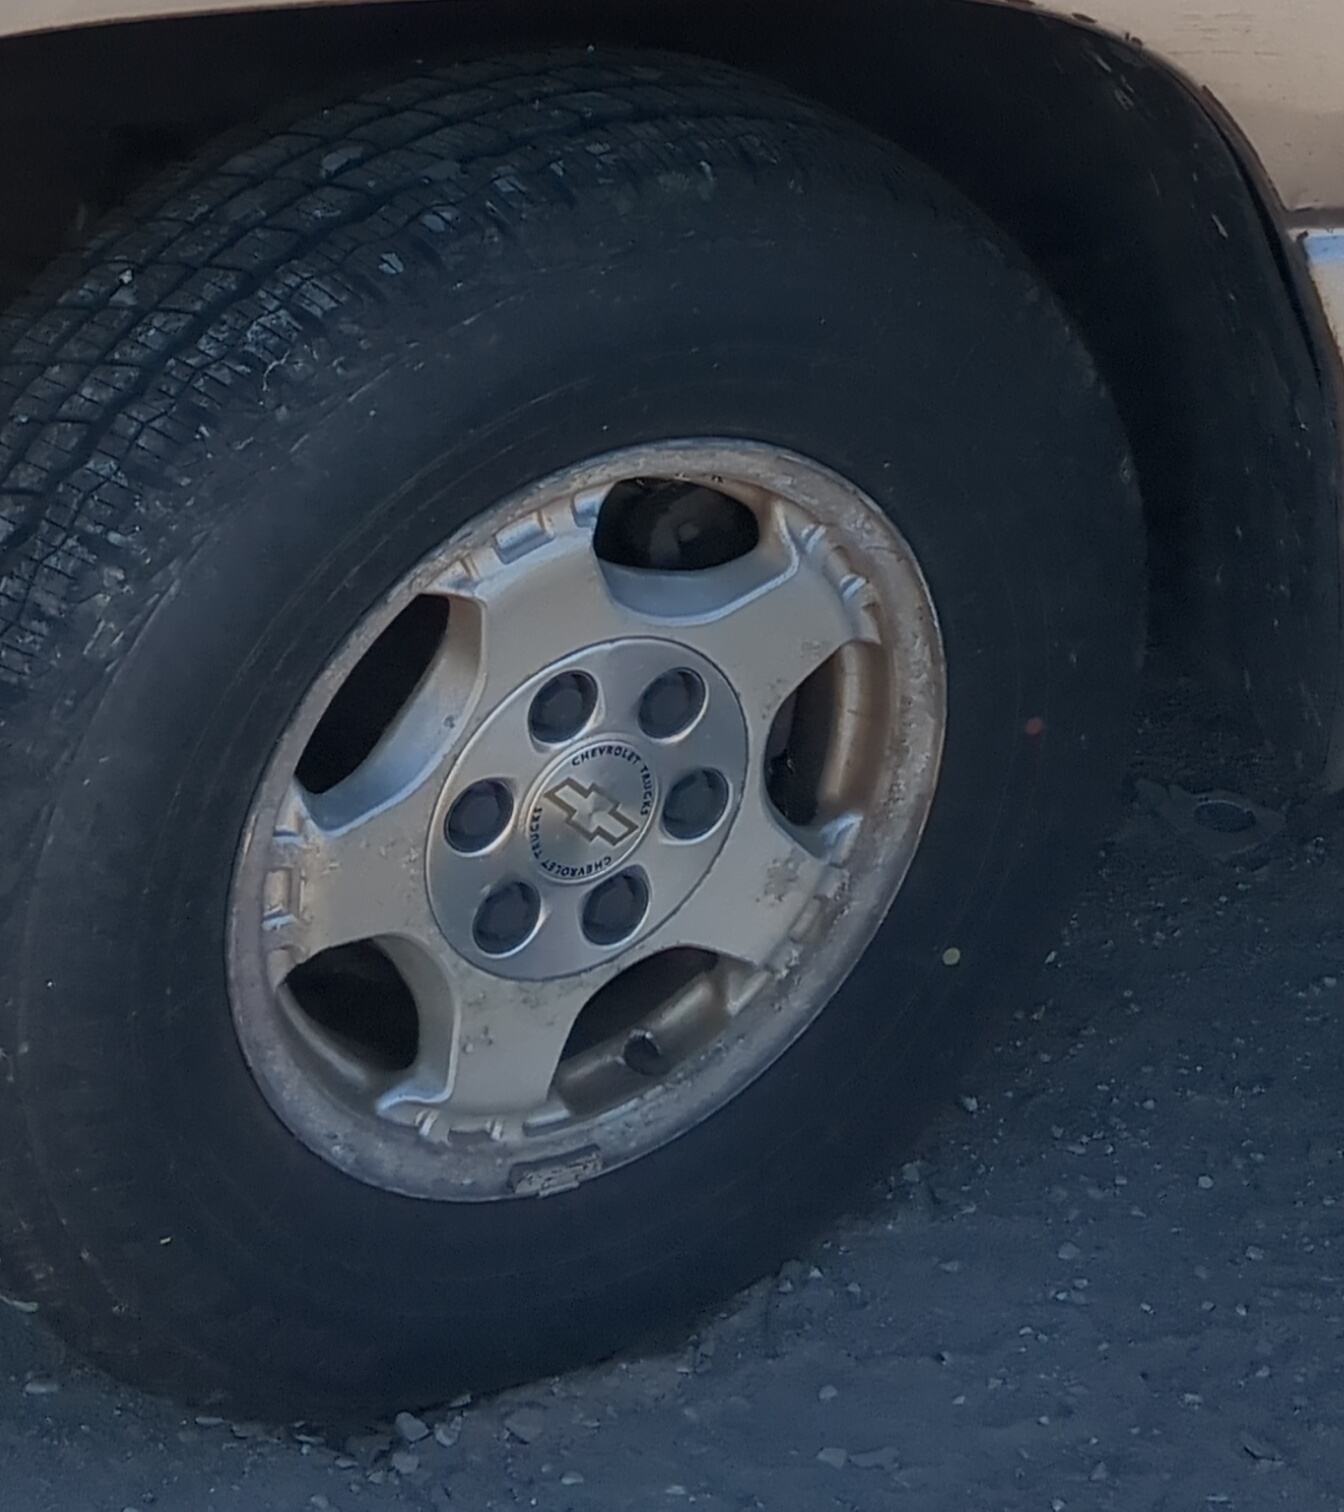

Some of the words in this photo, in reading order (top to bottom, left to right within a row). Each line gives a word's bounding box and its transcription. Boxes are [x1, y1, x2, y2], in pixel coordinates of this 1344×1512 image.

[571, 744, 642, 767] CHEVROLET
[639, 764, 653, 816] TRUCKS
[529, 806, 543, 859] TRUCKS
[540, 855, 612, 878] CHEVROLET
